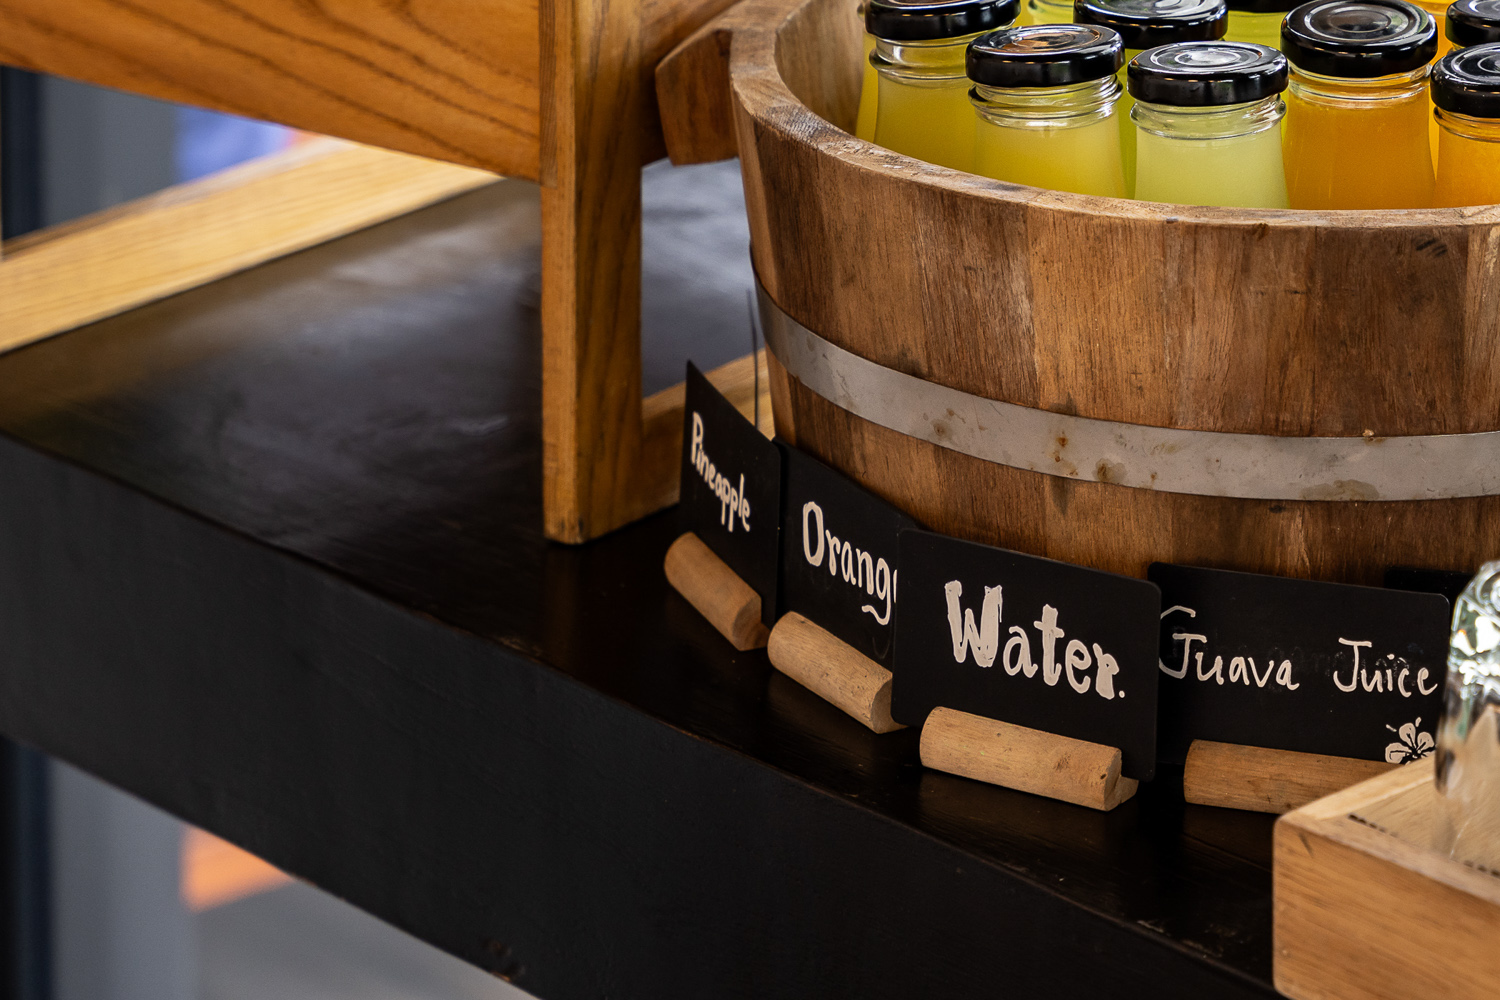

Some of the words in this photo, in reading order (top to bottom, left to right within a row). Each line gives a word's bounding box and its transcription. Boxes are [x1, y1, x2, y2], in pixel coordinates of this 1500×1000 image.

[691, 411, 751, 532] Pineapple
[802, 501, 898, 625] Orang
[1332, 636, 1439, 698] Juice
